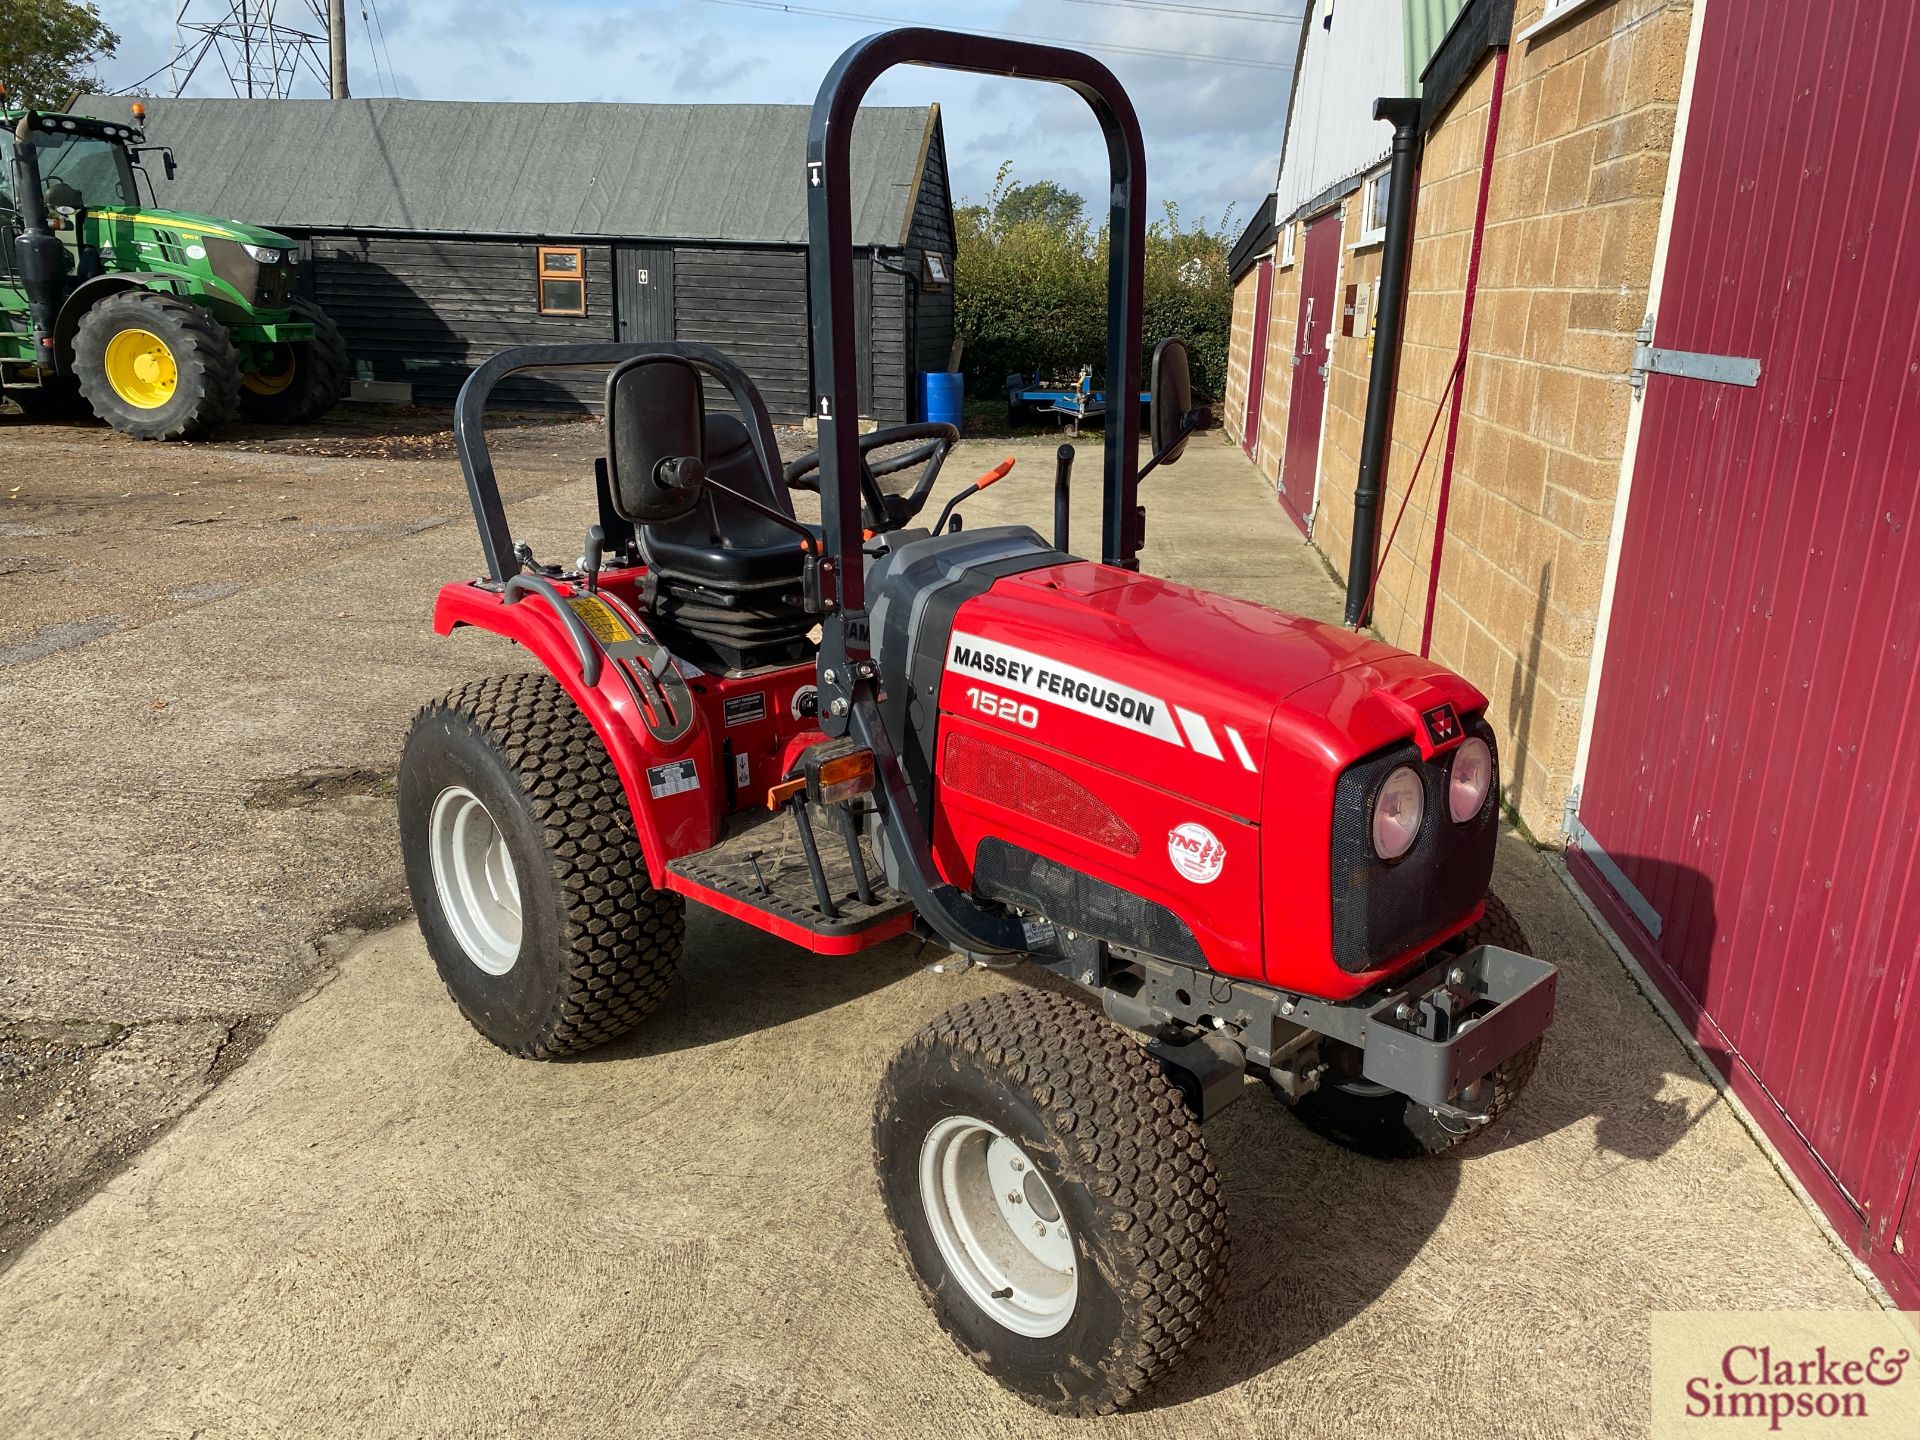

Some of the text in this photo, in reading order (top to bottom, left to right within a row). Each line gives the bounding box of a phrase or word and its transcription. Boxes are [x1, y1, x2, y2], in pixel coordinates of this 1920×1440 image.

[953, 645, 1155, 726] MASSEY FERGUSON
[966, 687, 1039, 730] 1520
[1169, 831, 1202, 853] TNS
